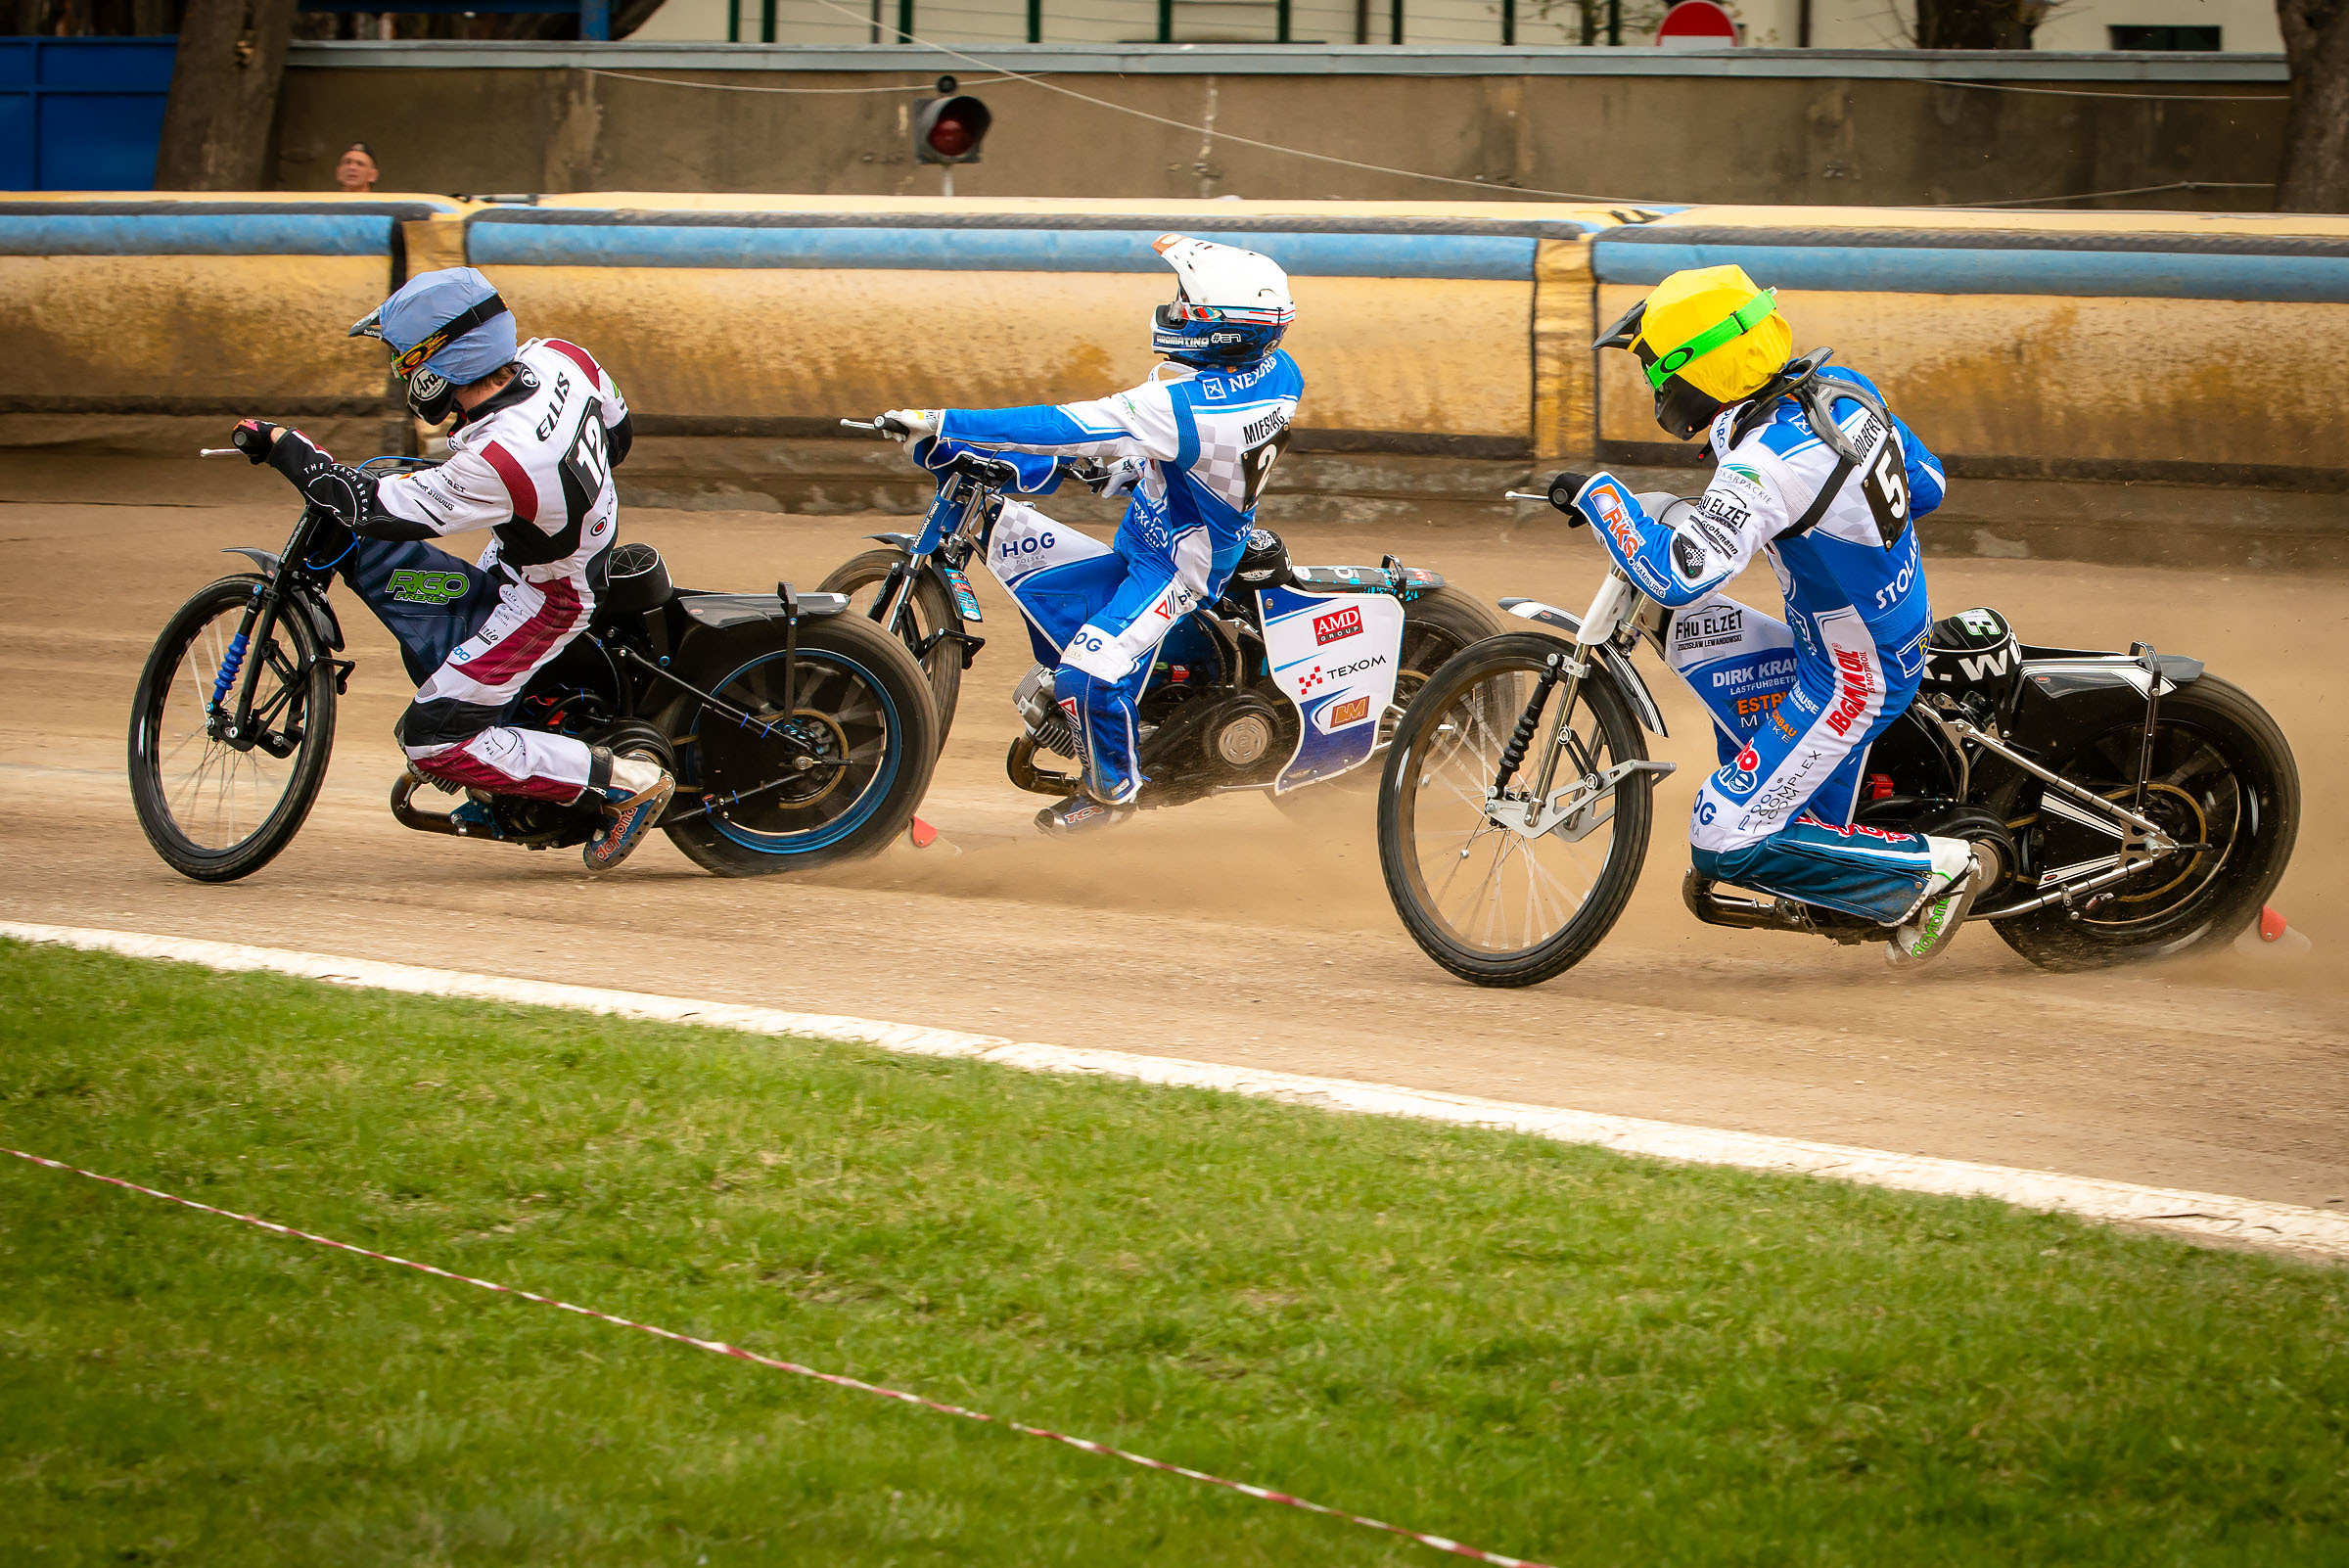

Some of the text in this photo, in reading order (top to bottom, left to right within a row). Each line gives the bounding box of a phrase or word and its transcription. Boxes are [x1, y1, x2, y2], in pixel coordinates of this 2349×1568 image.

[415, 374, 442, 396] Ara
[536, 371, 571, 441] ELLIS
[576, 415, 608, 488] 12
[303, 462, 325, 475] THE
[329, 465, 357, 483] EACH
[1255, 443, 1277, 497] 2
[1874, 449, 1906, 519] 5
[1709, 498, 1752, 530] ELZET
[1001, 531, 1055, 558] HOG
[1701, 520, 1738, 555] Grohmann
[1016, 554, 1045, 565] POLSKA
[386, 569, 470, 598] RIGO
[1634, 562, 1665, 597] HAMBURG
[394, 592, 450, 605] FRERES
[1317, 610, 1359, 635] AMD
[1320, 625, 1359, 642] GROUP
[1675, 610, 1743, 639] FHU ELZET
[1074, 632, 1103, 653] OG
[1704, 634, 1742, 647] LEWANDOWSKI
[1327, 655, 1387, 679] TEXOM
[1713, 666, 1754, 687] DIRK
[1335, 699, 1366, 724] BM
[1065, 806, 1105, 823] TCX
[1693, 789, 1717, 826] OG
[594, 807, 638, 861] daytona
